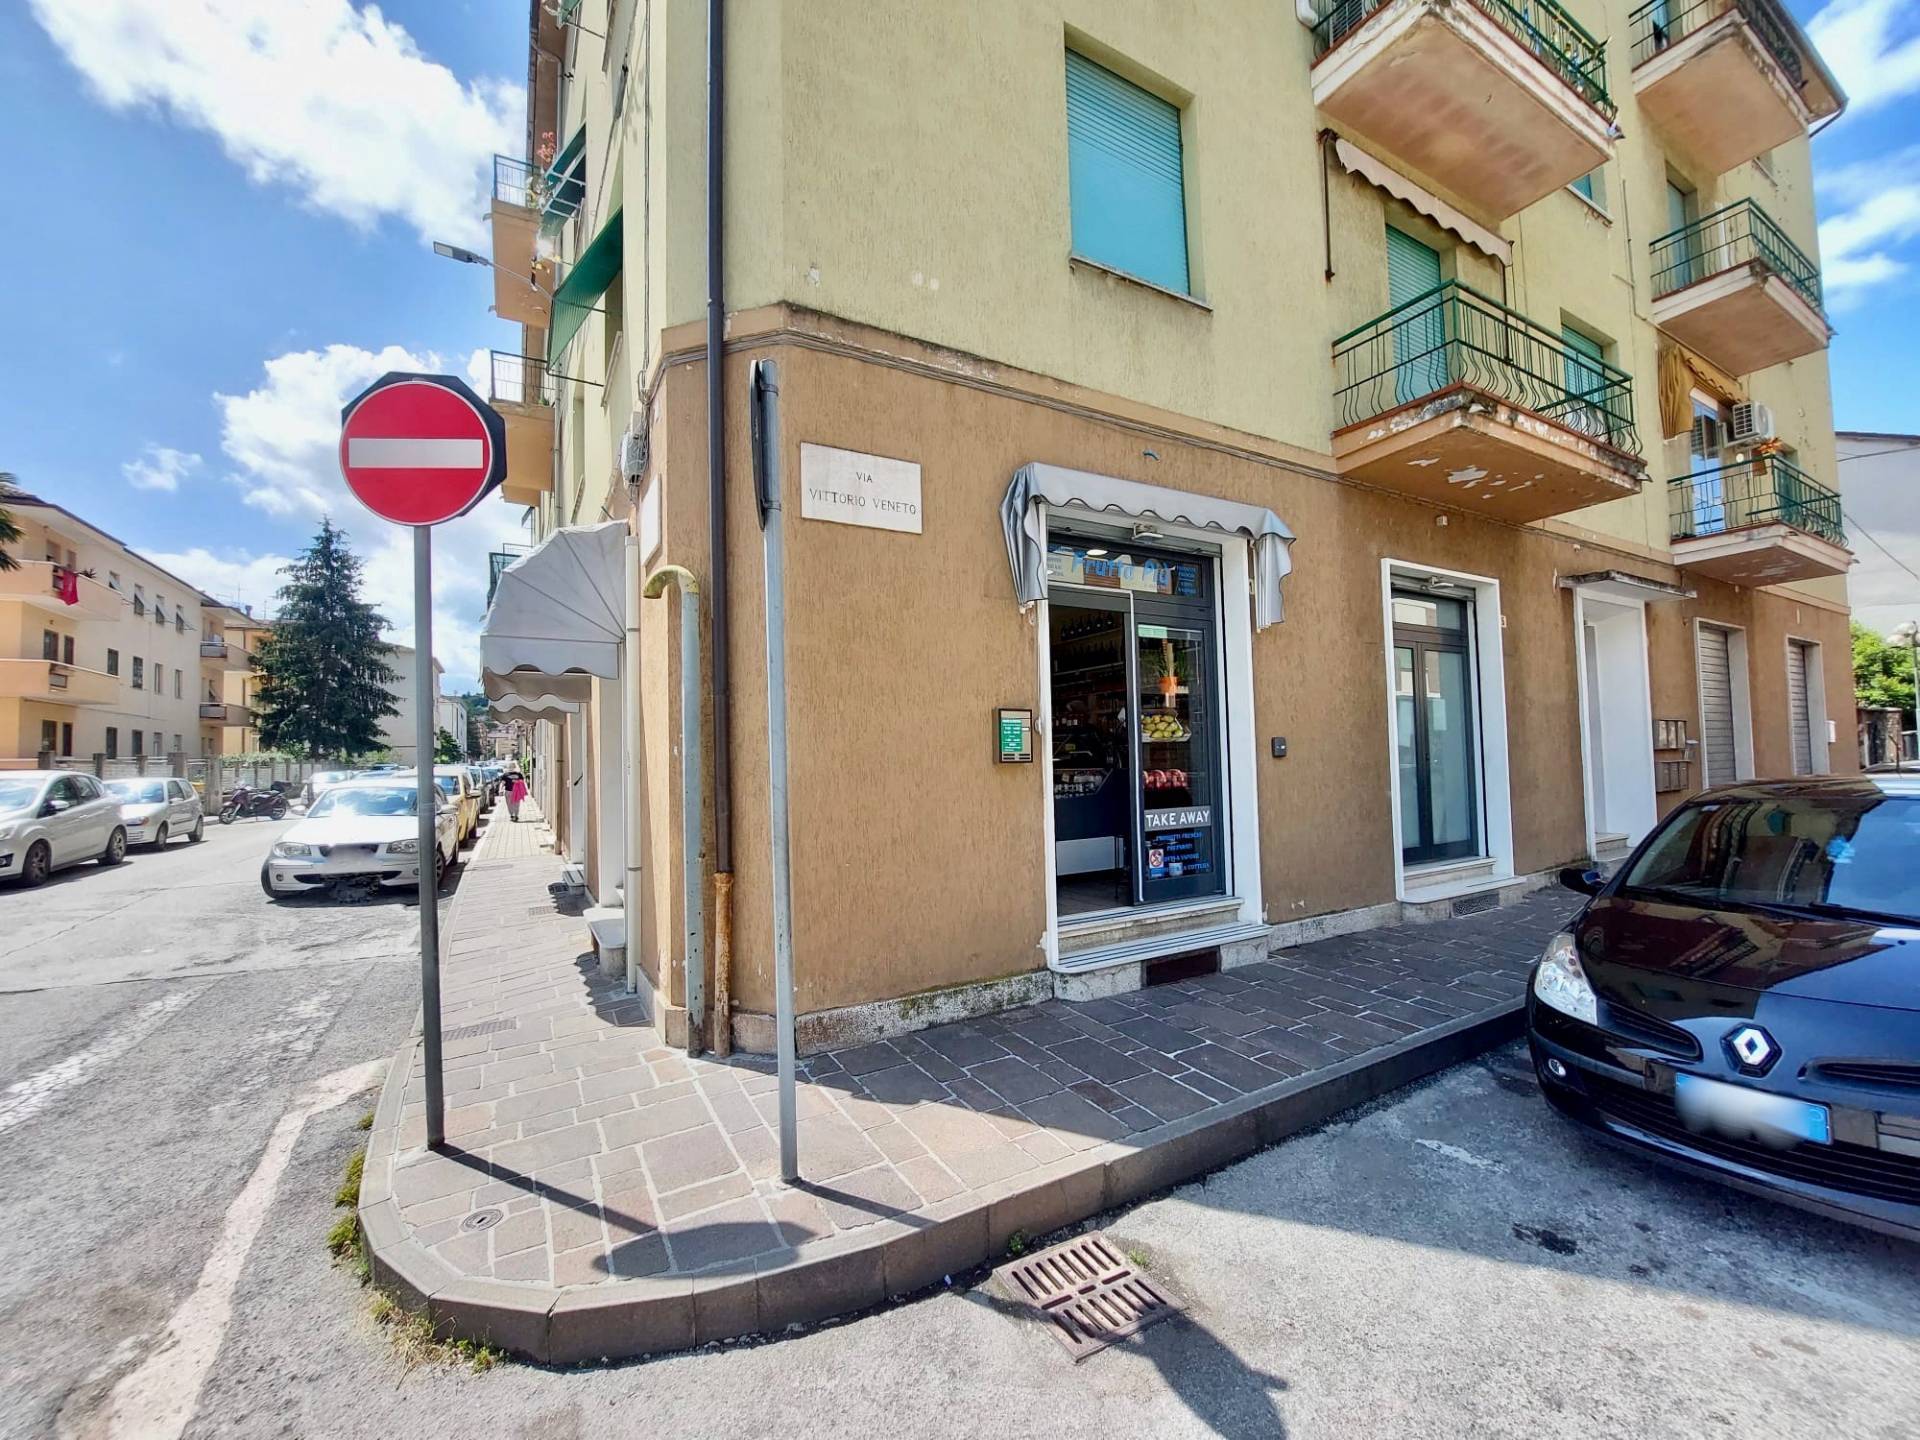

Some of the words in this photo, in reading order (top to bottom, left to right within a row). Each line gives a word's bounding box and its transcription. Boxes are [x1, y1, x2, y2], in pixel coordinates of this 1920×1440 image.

[856, 472, 873, 483] VIA
[809, 488, 866, 507] VITTORIO
[872, 498, 917, 515] VENETO
[1145, 812, 1177, 828] TAKE
[1179, 809, 1210, 825] AWAY
